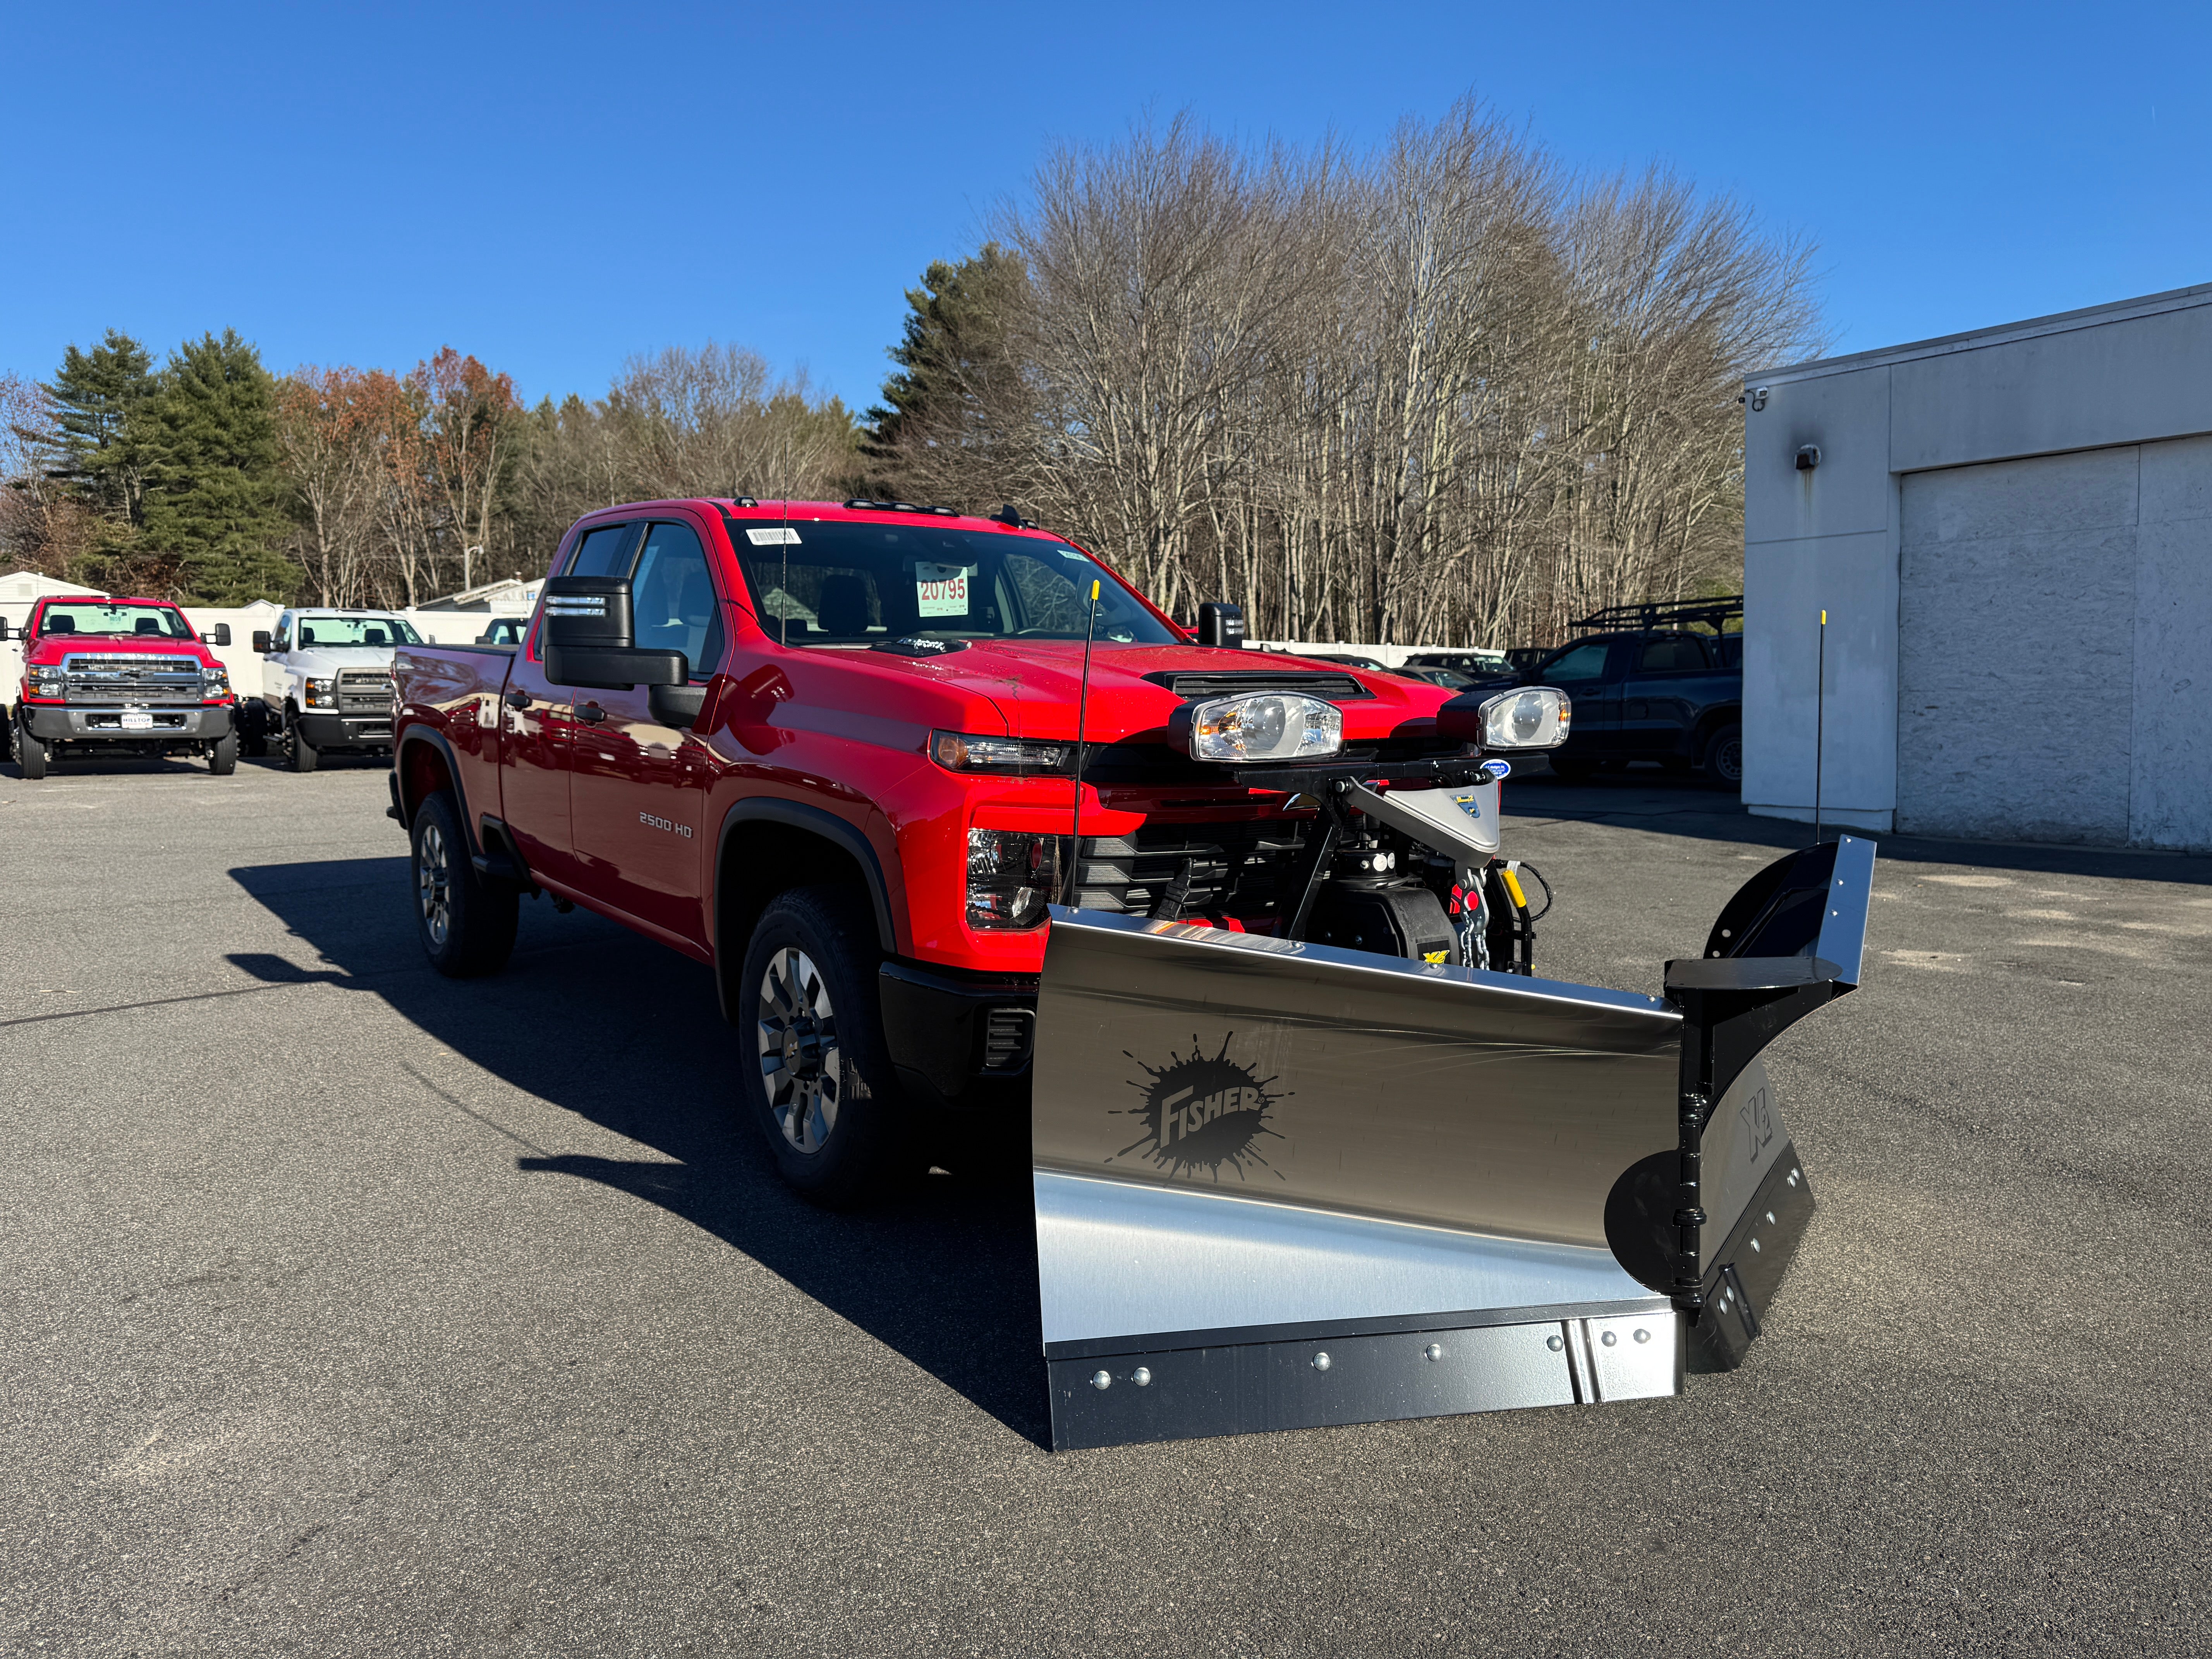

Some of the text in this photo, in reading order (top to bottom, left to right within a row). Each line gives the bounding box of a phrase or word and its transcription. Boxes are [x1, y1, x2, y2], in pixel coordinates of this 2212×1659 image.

[921, 579, 965, 600] 20795
[640, 812, 692, 838] 2500 HD
[1423, 950, 1450, 963] XV2
[1160, 1085, 1262, 1148] FISHER
[1740, 1087, 1773, 1164] XV2
